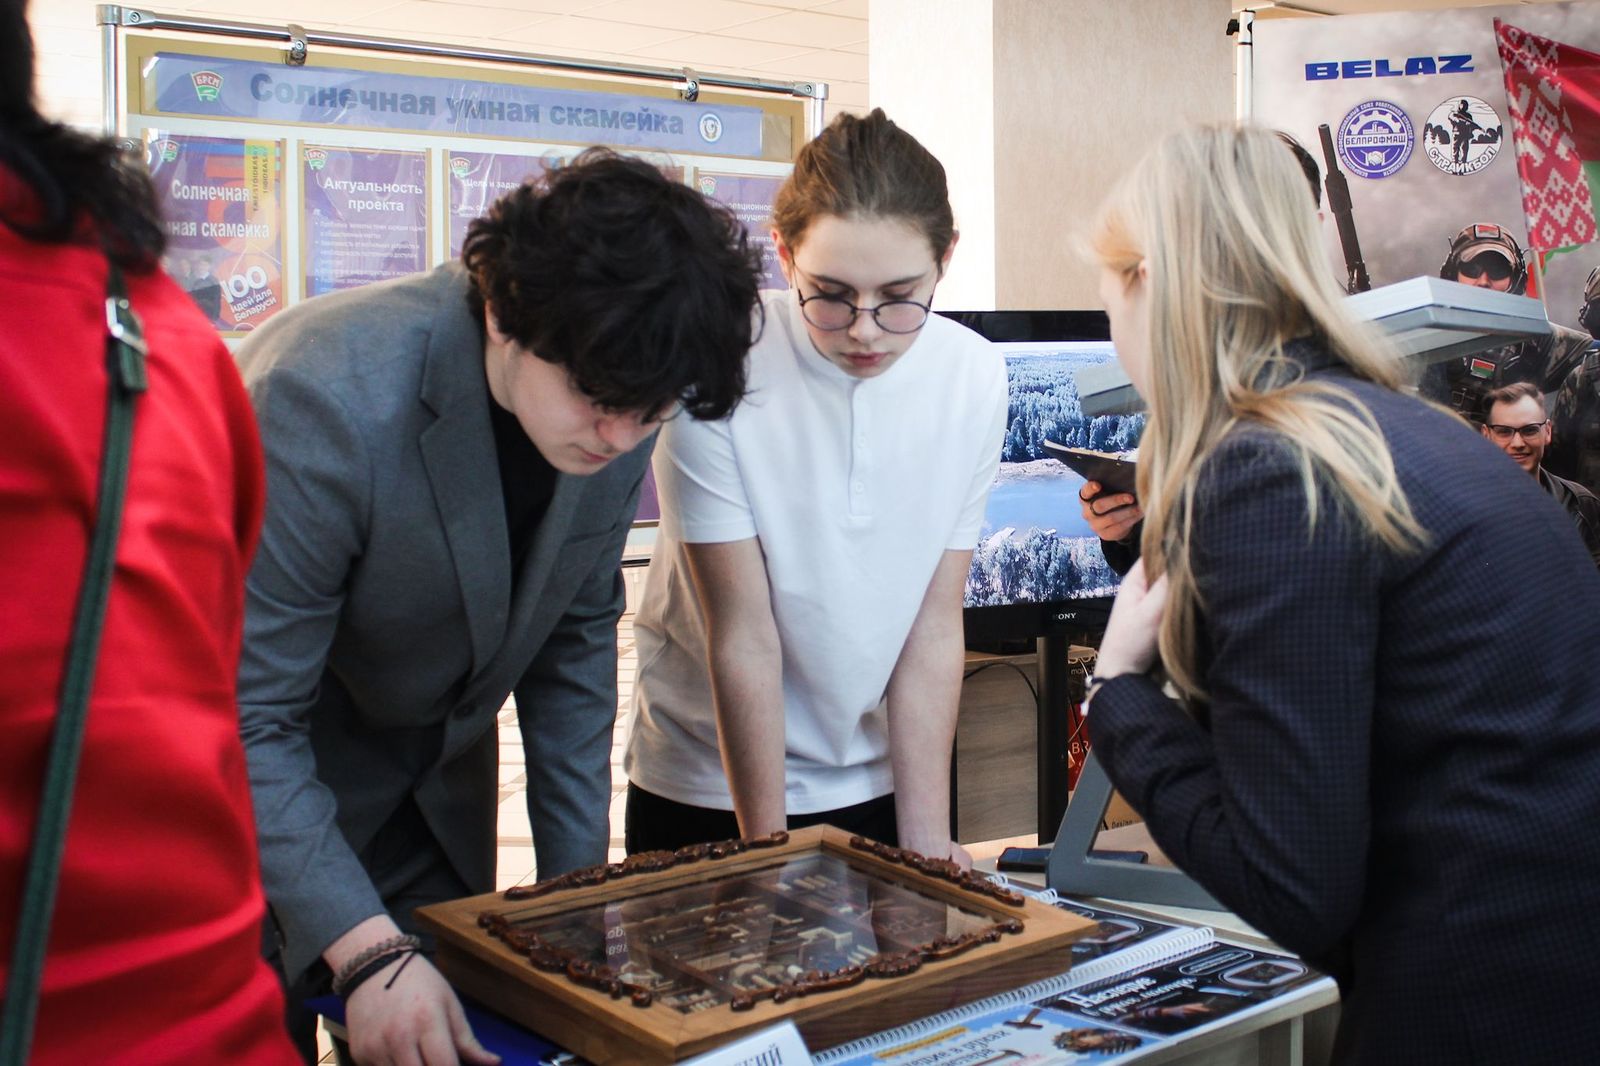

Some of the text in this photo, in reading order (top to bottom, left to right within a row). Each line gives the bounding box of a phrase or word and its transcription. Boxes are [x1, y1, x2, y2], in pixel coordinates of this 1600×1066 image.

[1305, 54, 1475, 81] BELAZ
[251, 73, 684, 135] Солнечная умная скамейка
[1345, 134, 1406, 146] БЕЛПРОФМАШ
[1428, 145, 1497, 173] СТРАЙКБОЛ
[172, 179, 250, 201] Солнечная
[324, 177, 423, 194] Актуальность
[348, 199, 404, 212] проекта
[220, 265, 267, 304] 100
[256, 288, 273, 303] для
[234, 297, 277, 322] Беларуси
